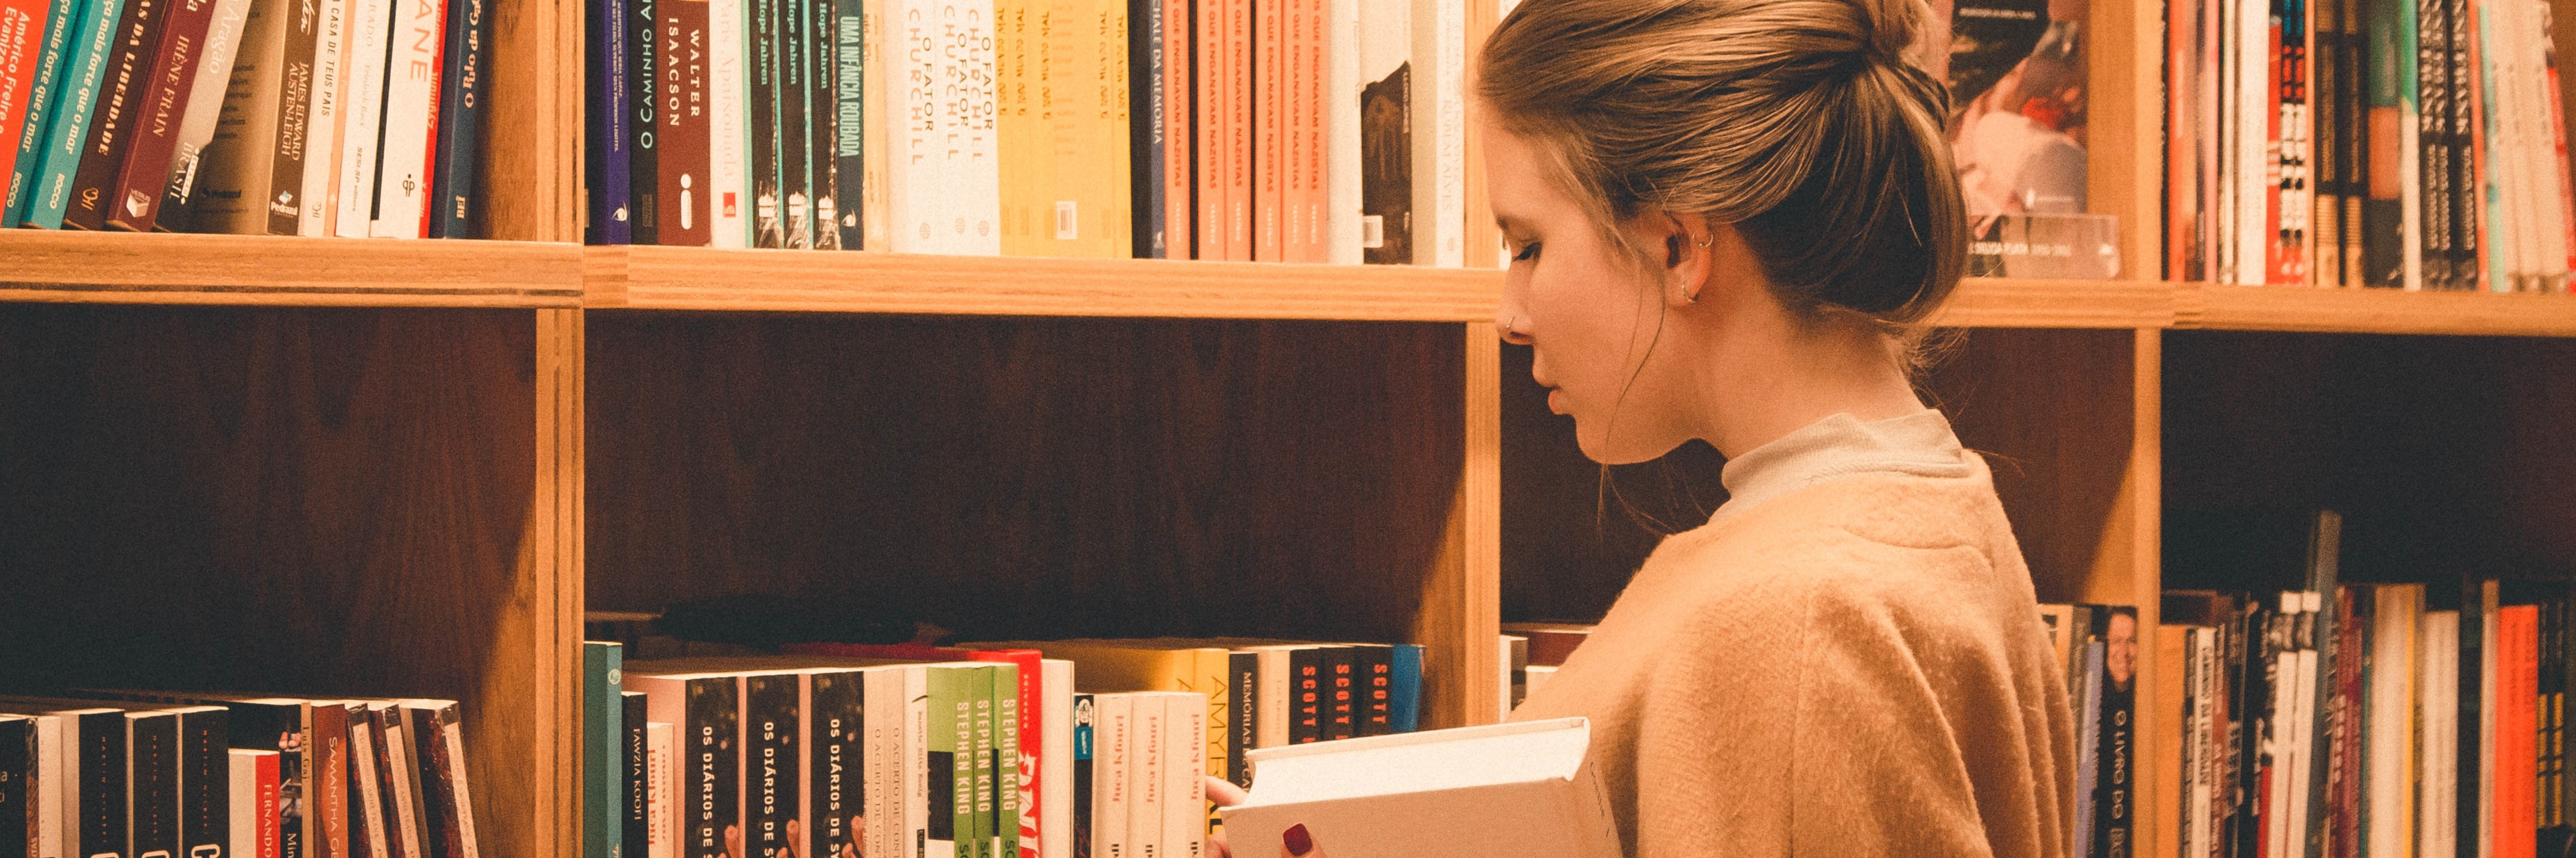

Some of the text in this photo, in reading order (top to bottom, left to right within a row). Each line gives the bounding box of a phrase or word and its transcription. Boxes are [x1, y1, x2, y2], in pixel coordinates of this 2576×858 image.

[7, 11, 30, 73] Américo
[129, 23, 143, 47] DA
[210, 6, 240, 74] Aragão
[322, 7, 340, 117] CASA DE TEUS PAIS
[463, 53, 476, 89] Pulo
[468, 29, 478, 51] da
[669, 17, 679, 126] ISAACSON
[690, 30, 700, 117] WALTER
[818, 2, 829, 89] Hope Jahren
[1153, 49, 1162, 68] DA
[22, 13, 66, 153] mais forte que o mar
[65, 18, 110, 154] mais forte que o mar
[99, 55, 135, 156] LIBERDADE
[153, 35, 190, 137] IRÈNE FRAIN
[282, 63, 298, 156] AUSTEN-LEIGH
[292, 62, 309, 161] JAMES EDWARD
[464, 93, 474, 108] O
[641, 29, 653, 149] O CAMINHO
[840, 16, 861, 156] UMA INFÂNCIA ROUBADA
[909, 9, 923, 165] CHURCHILL
[923, 37, 933, 131] O FATOR
[945, 5, 959, 160] CHURCHILL
[958, 33, 968, 127] O FATOR
[969, 9, 982, 161] CHURCHILL
[982, 37, 992, 129] O FATOR
[1153, 74, 1163, 143] MEMÓRIA
[1311, 16, 1320, 190] QUE ENGANAVAM NAZISTAS
[6, 172, 22, 208] ROCCO
[50, 173, 65, 209] ROCCO
[168, 142, 193, 200] BRASIL
[830, 719, 840, 737] OS
[894, 728, 899, 737] O
[1243, 672, 1251, 750] MEMÓRIAS
[1303, 666, 1316, 726] SCOTT
[1336, 664, 1349, 724] SCOTT
[1373, 664, 1387, 724] SCOTT
[2115, 710, 2126, 726] O
[875, 729, 881, 738] O
[957, 702, 970, 814] STEPHEN KING
[977, 700, 990, 812] STEPHEN KING
[1003, 699, 1016, 810] STEPHEN KING
[2113, 731, 2125, 784] LIVRO
[329, 737, 337, 832] SAMANTHA
[703, 726, 715, 847] OS DIÁRIOS DE
[764, 722, 776, 841] OS DIÁRIOS DE
[830, 745, 842, 811] DIÁRIOS
[875, 803, 881, 820] DE
[894, 802, 900, 819] DE
[2113, 790, 2124, 819] DO
[263, 785, 273, 858] FERNANDO
[830, 818, 839, 837] DE
